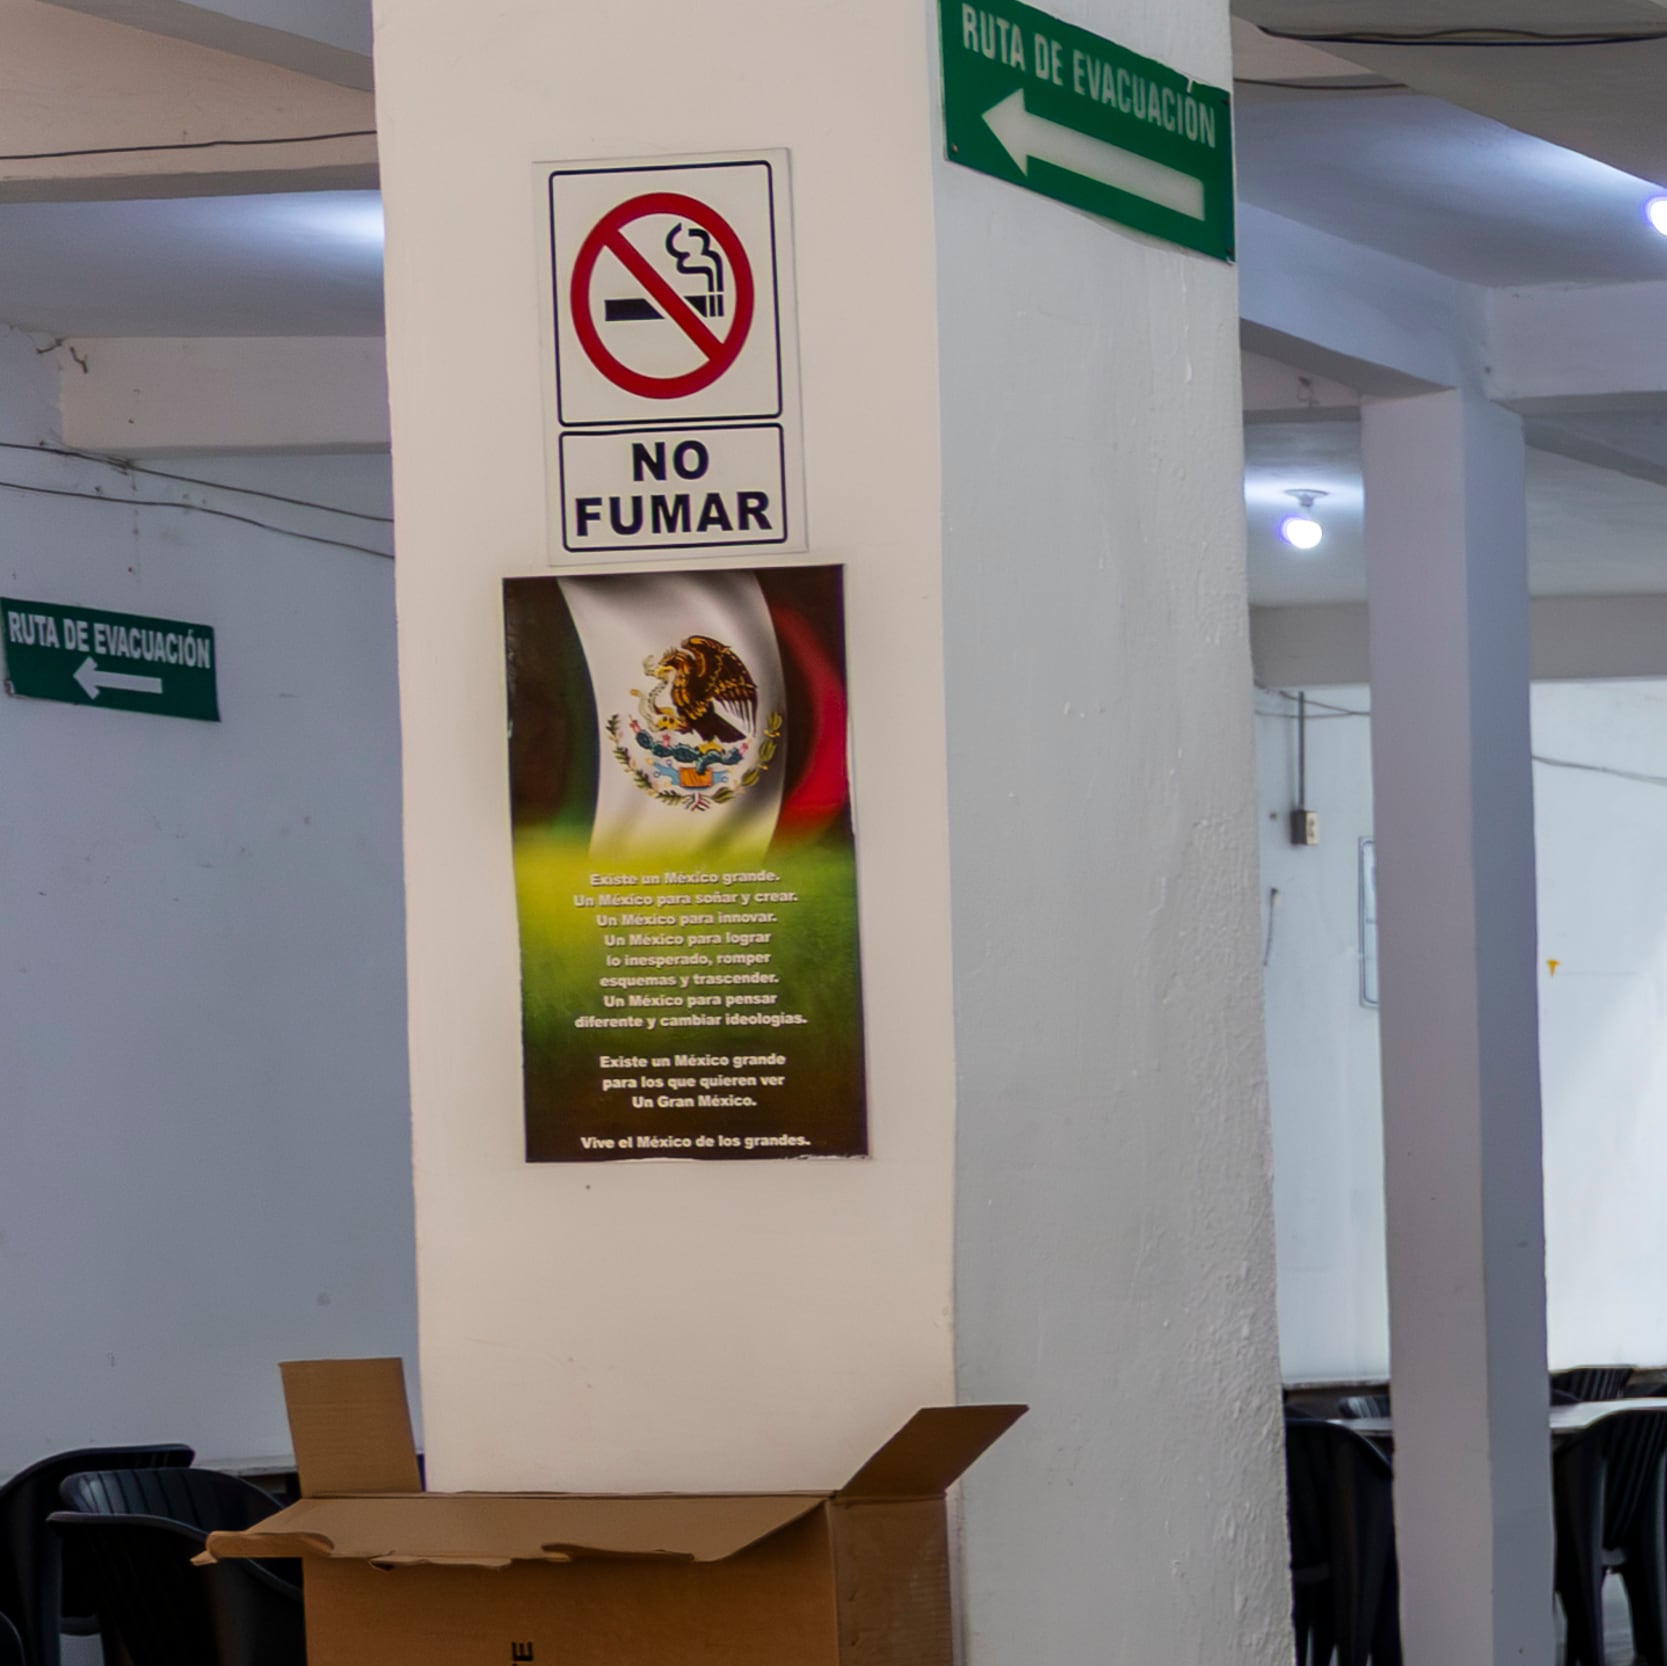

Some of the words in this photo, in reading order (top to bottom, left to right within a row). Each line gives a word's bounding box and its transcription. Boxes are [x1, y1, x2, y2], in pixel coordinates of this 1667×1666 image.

[961, 3, 1026, 72] RUTA
[1034, 33, 1064, 86] DE
[1073, 49, 1217, 149] EVACUACIÓN
[631, 439, 710, 484] NO
[574, 490, 772, 538] FUMAR
[7, 611, 60, 649] RUTA
[63, 617, 90, 653] DE
[94, 621, 211, 669] EVACUACIÓN
[590, 873, 639, 887] Existe
[642, 875, 660, 886] un
[664, 871, 719, 885] México
[722, 870, 781, 887] grande.
[574, 895, 595, 908] Un
[598, 893, 653, 908] México
[657, 894, 692, 908] para
[696, 891, 739, 905] soñar
[741, 894, 751, 906] y
[754, 891, 799, 903] crear.
[596, 914, 617, 927] Un
[622, 912, 677, 926] México
[680, 914, 715, 927] para
[718, 912, 778, 924] innovar.
[604, 934, 625, 947] Un
[629, 932, 684, 946] México
[688, 934, 722, 947] para
[726, 931, 772, 947] lograr
[606, 954, 621, 967] lo
[624, 954, 713, 969] inesperado,
[716, 953, 772, 967] romper
[600, 975, 677, 989] esquemas
[680, 975, 691, 988] y
[693, 972, 780, 985] trascender.
[603, 995, 625, 1008] Un
[628, 993, 684, 1008] México
[687, 995, 723, 1009] para
[725, 993, 778, 1008] pensar
[575, 1015, 643, 1029] diferente
[645, 1017, 656, 1030] y
[660, 1013, 723, 1027] cambiar
[600, 1055, 648, 1069] Existe
[651, 1057, 671, 1068] un
[674, 1053, 729, 1067] México
[732, 1052, 787, 1069] grande
[602, 1077, 638, 1091] para
[641, 1075, 664, 1088] los
[667, 1077, 697, 1090] que
[699, 1074, 757, 1090] quieren
[760, 1076, 786, 1086] ver
[632, 1096, 654, 1108] Un
[657, 1096, 695, 1108] Gran
[698, 1093, 758, 1108] México.
[580, 1136, 615, 1149] Vive
[618, 1136, 633, 1149] el
[637, 1135, 692, 1149] México
[695, 1135, 716, 1148] de
[718, 1134, 741, 1147] los
[744, 1133, 812, 1150] grandes.
